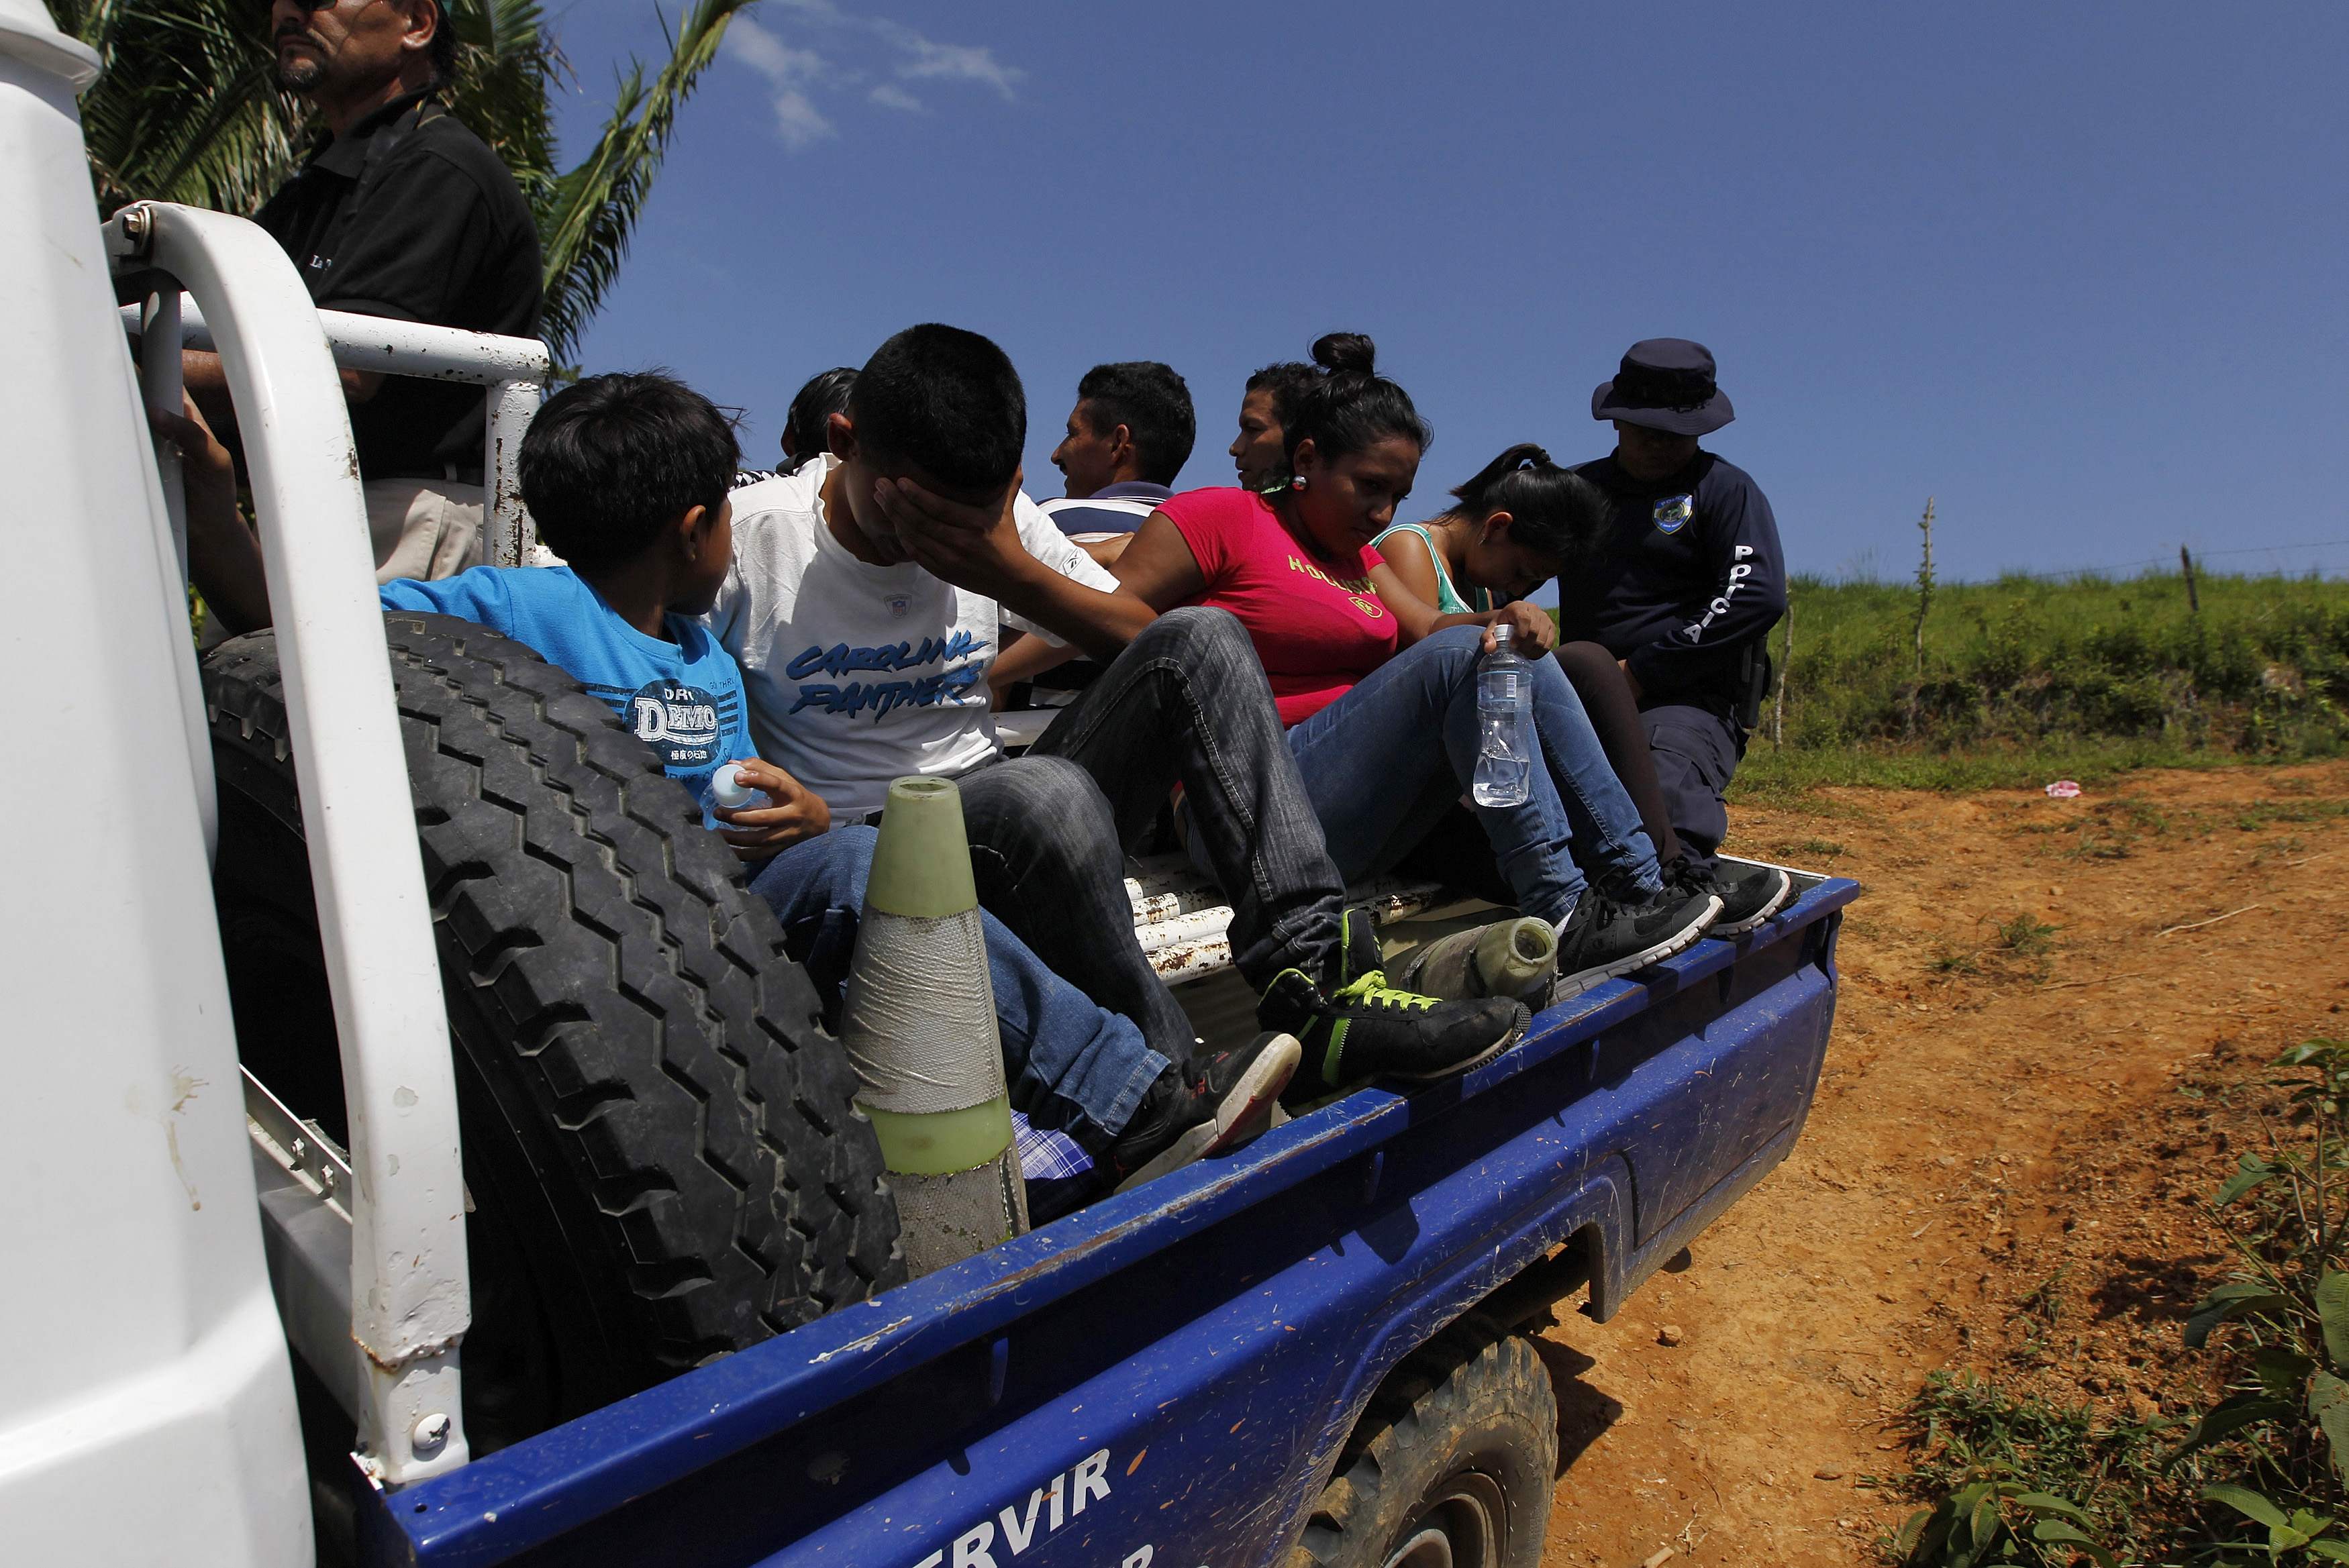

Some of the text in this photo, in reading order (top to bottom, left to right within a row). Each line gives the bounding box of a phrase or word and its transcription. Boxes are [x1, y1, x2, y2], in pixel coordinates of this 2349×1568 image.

[1683, 545, 1754, 644] POLICIA
[786, 629, 991, 680] CAROLINA
[634, 697, 717, 742] DEMO
[911, 1449, 1111, 1568] RVIR
